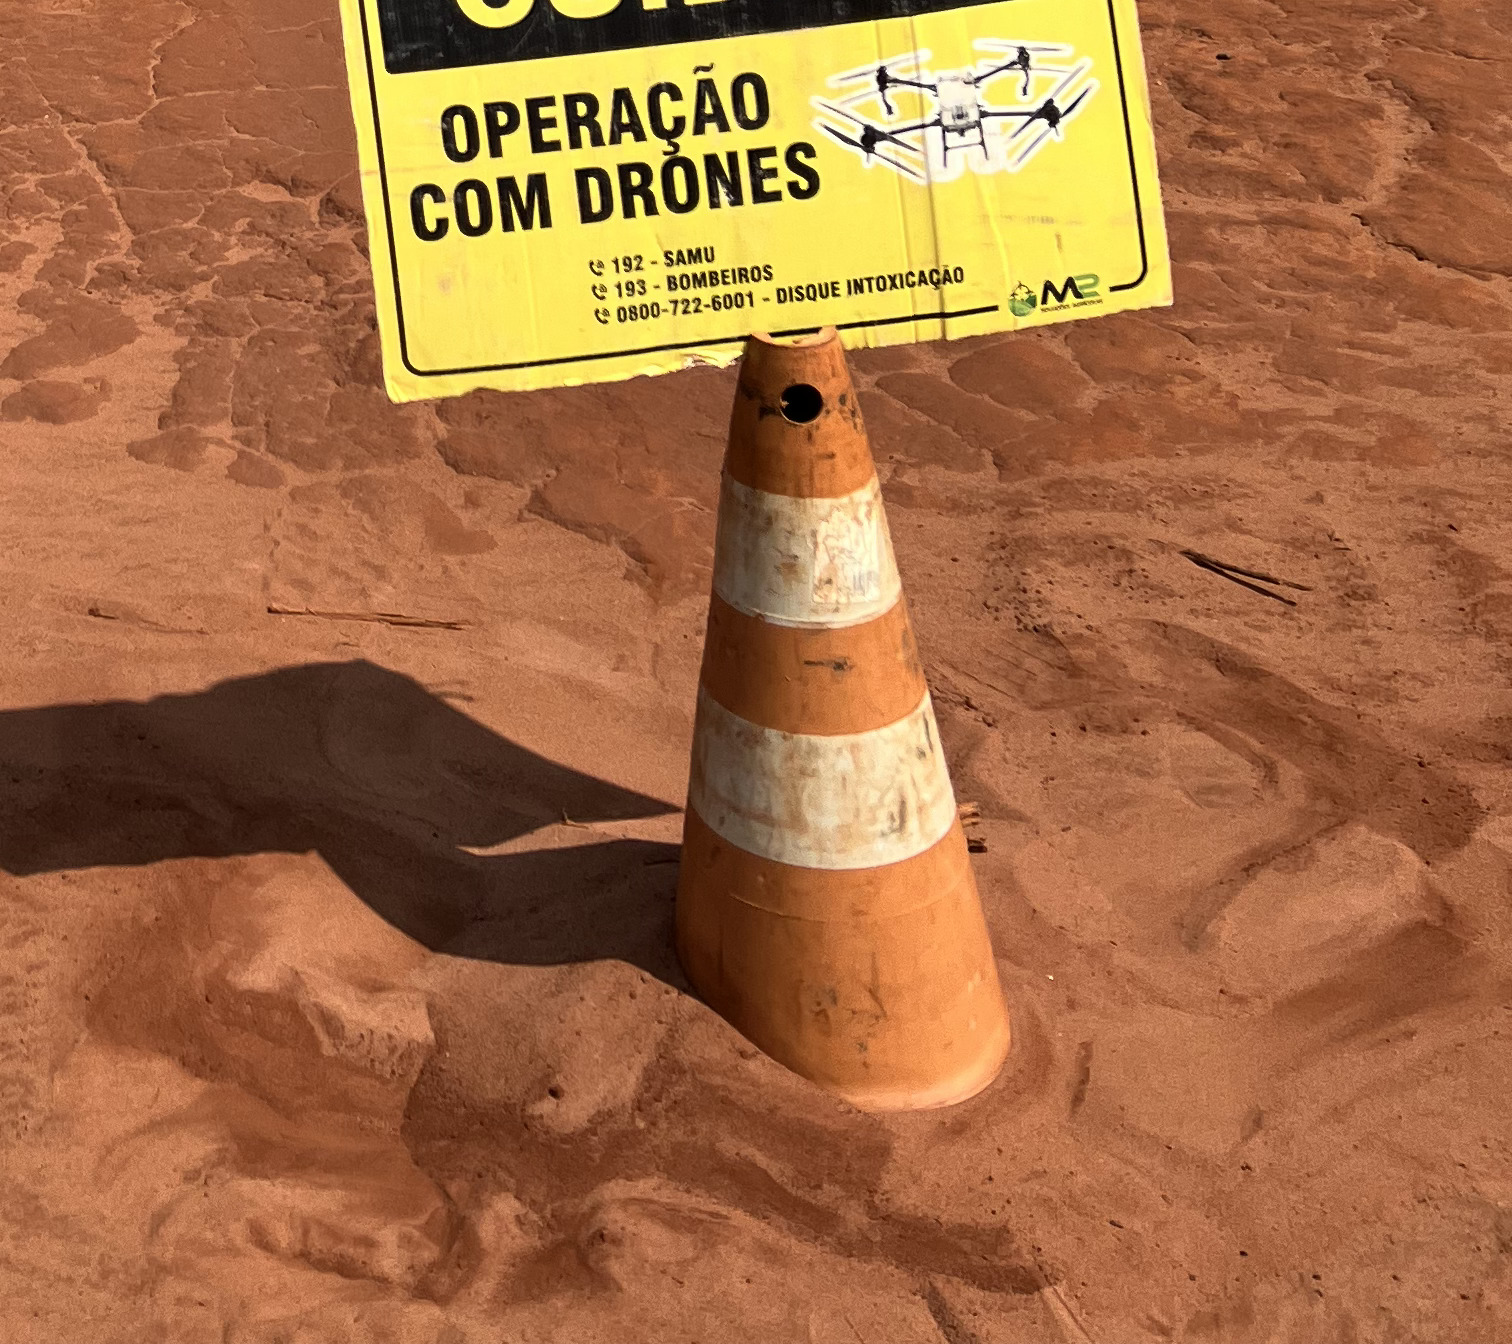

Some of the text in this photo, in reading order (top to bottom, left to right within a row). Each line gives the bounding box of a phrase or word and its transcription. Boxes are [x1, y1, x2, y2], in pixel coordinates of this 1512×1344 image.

[439, 62, 771, 164] OPERAÇÃO
[409, 141, 821, 242] COM DRONES
[611, 254, 644, 274] 192
[663, 246, 715, 268] SAMU
[614, 279, 647, 298] 193
[666, 264, 774, 292] BOMBEIROS
[616, 290, 755, 323] 0800-722-6001
[775, 281, 840, 304] DISQUE
[846, 264, 965, 297] INTOXICAÇÃO
[1040, 273, 1100, 305] M2
